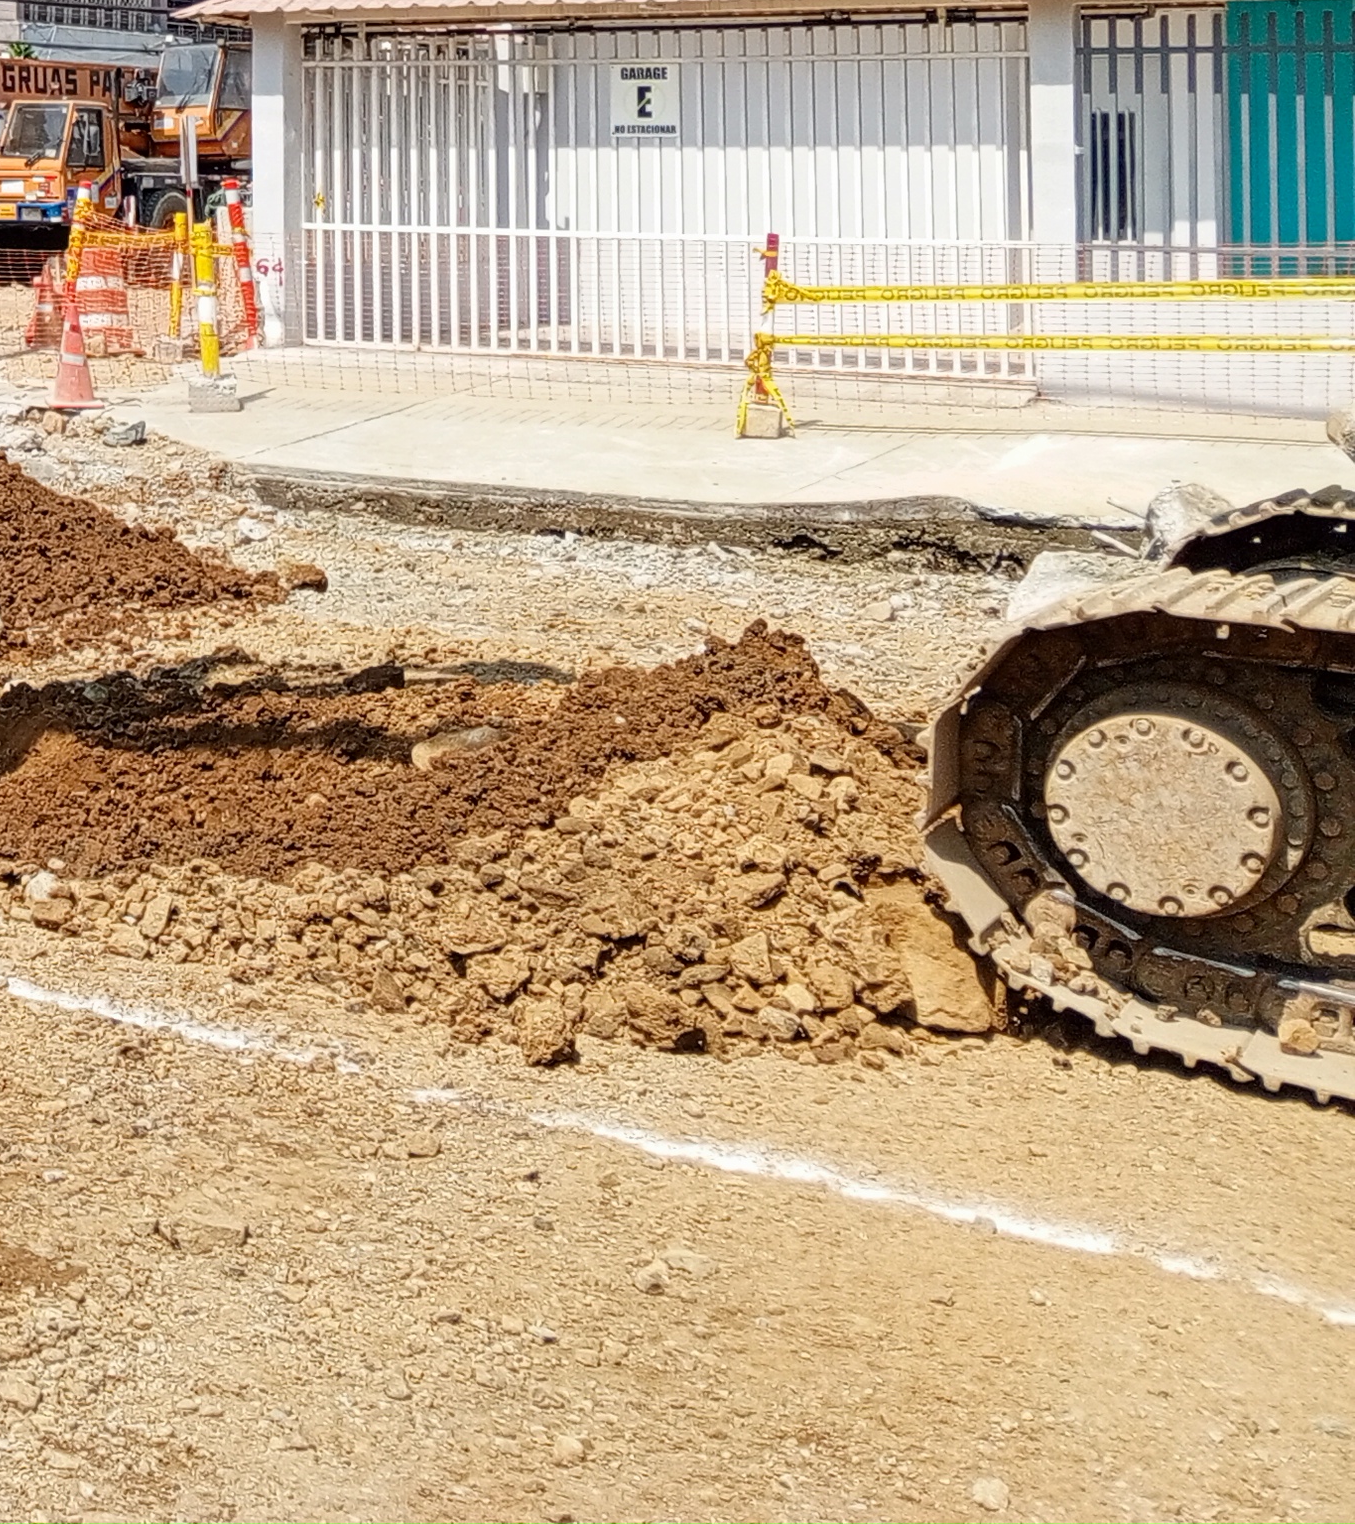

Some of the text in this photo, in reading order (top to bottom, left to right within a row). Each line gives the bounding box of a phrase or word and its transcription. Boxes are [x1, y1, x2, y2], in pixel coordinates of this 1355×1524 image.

[2, 65, 78, 95] GRUAS
[620, 67, 668, 80] GARAGE
[614, 125, 677, 134] NO ESTACIONAR
